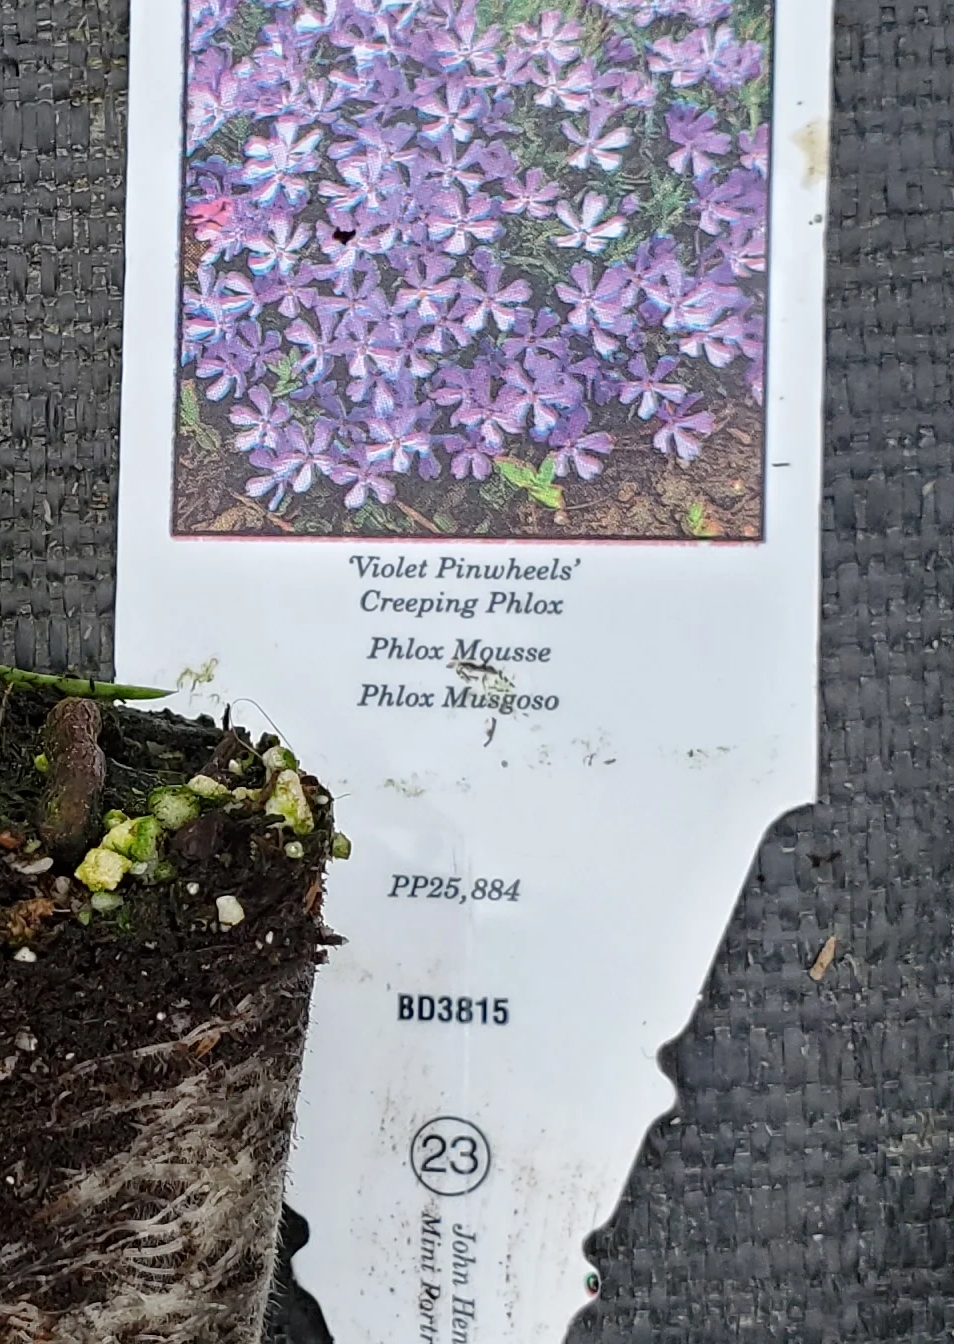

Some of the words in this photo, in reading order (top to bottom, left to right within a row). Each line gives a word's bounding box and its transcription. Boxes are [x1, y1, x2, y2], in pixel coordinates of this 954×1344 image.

[360, 590, 479, 619] Creeping
[485, 591, 564, 615] Phlox
[367, 637, 445, 660] Phlox
[451, 638, 552, 663] Mousse
[357, 684, 435, 707] Phlox
[441, 686, 560, 715] Musgoso
[387, 874, 521, 905] PP25,884
[397, 993, 510, 1026] BD3815
[421, 1134, 479, 1175] 23
[420, 1211, 442, 1273] Mini
[451, 1222, 477, 1286] John
